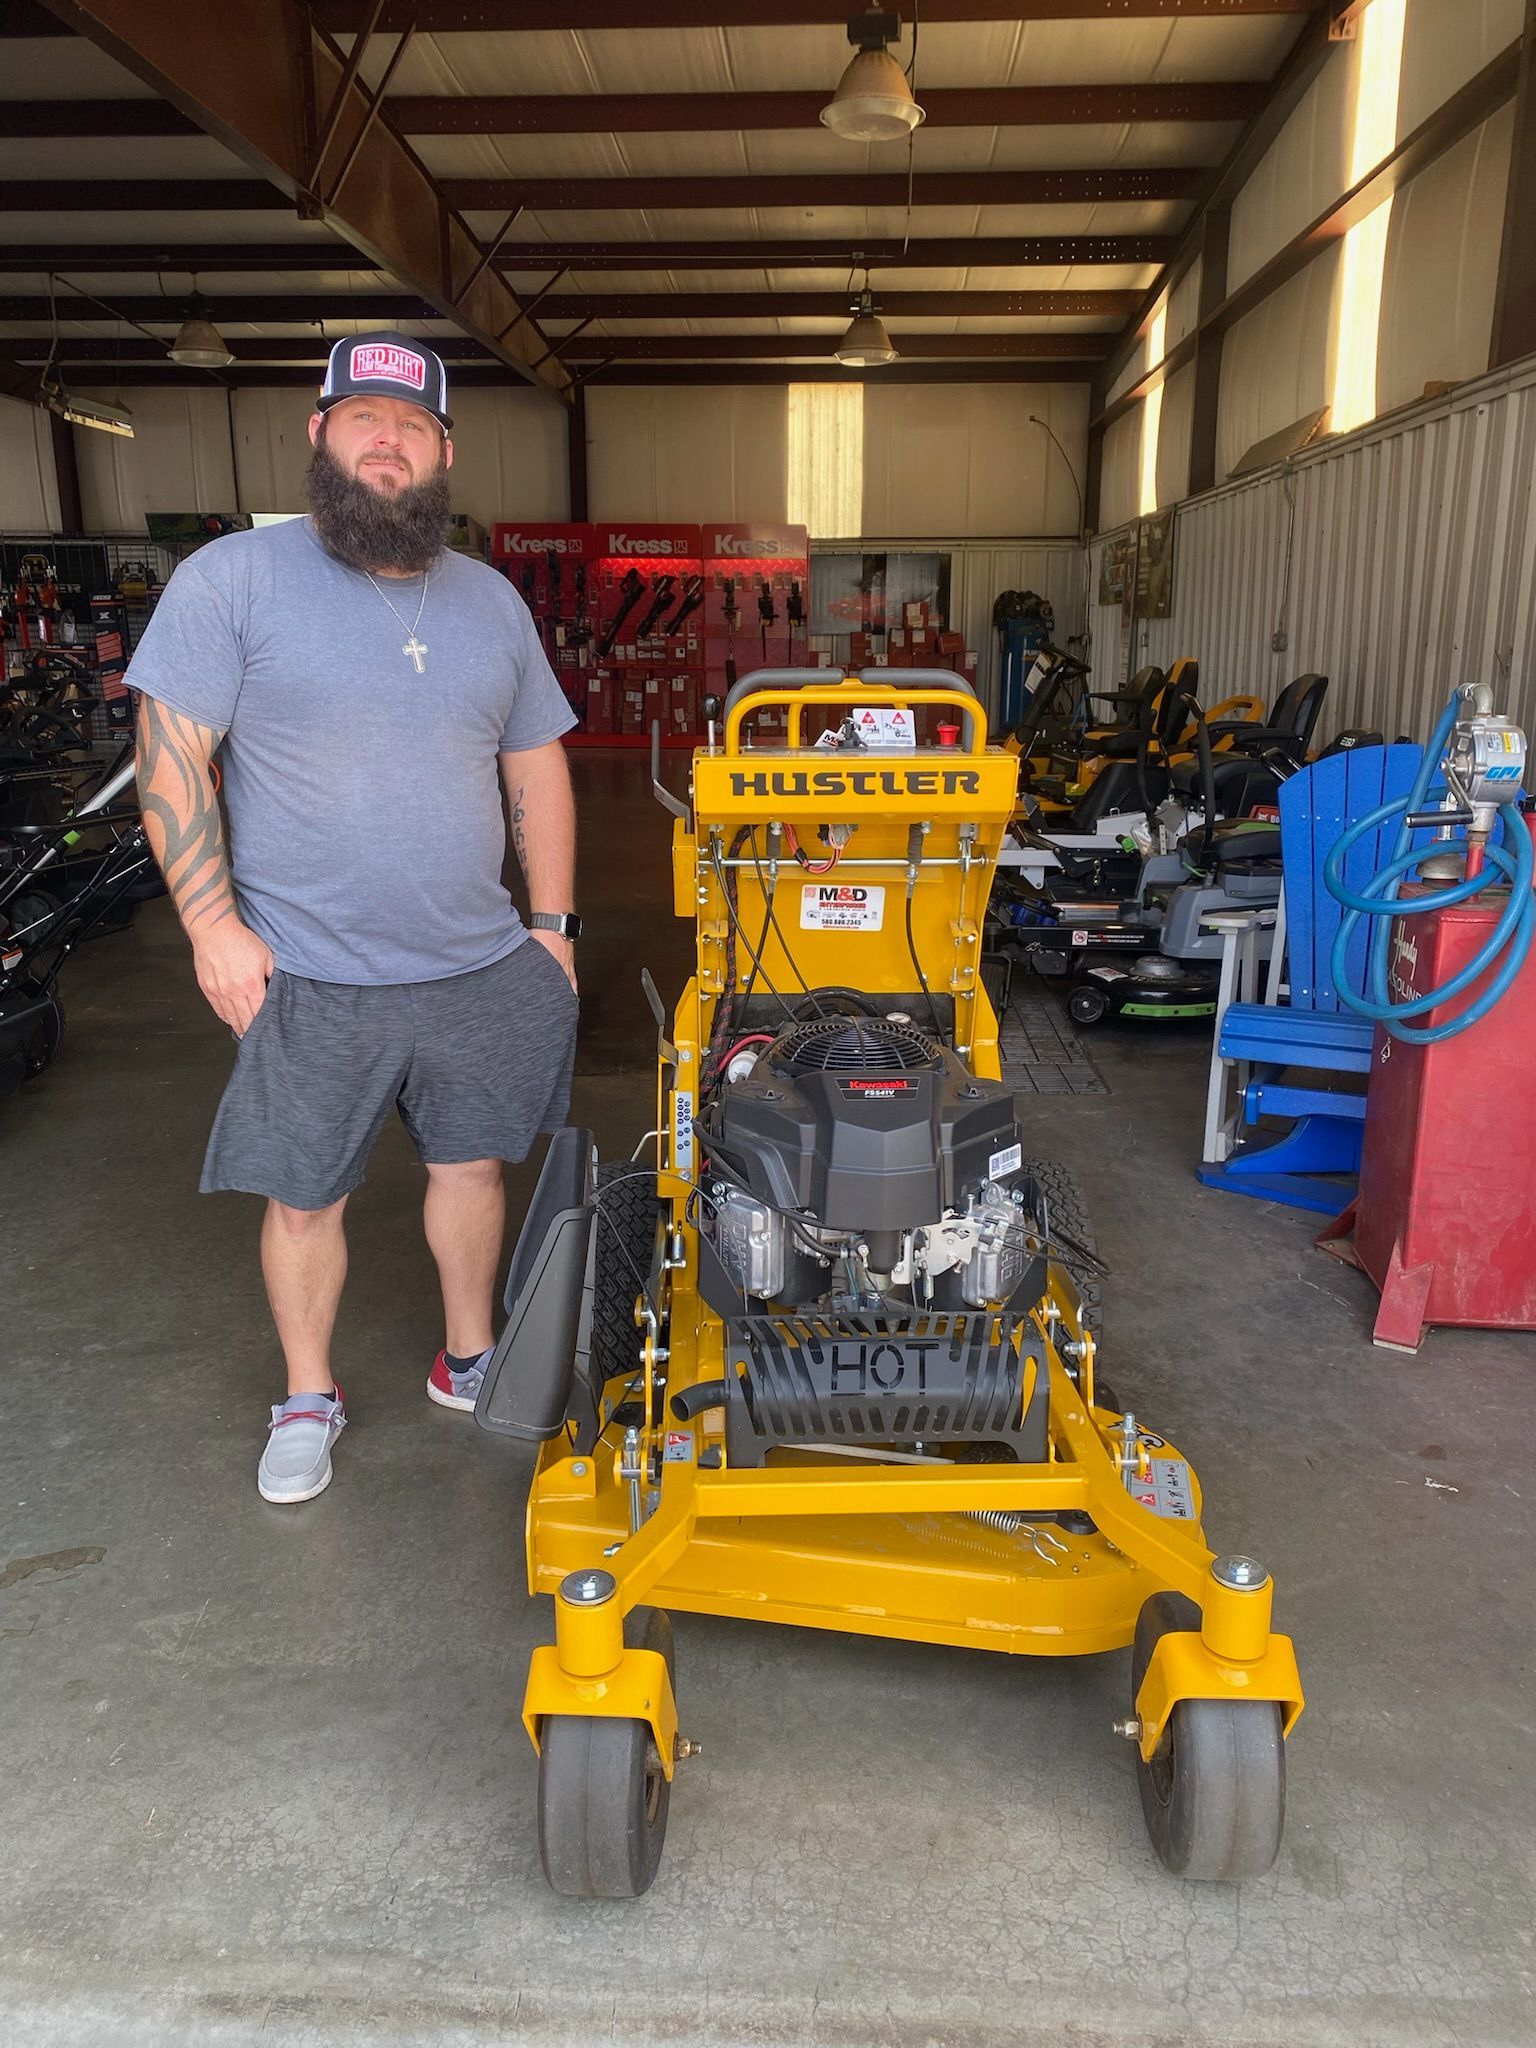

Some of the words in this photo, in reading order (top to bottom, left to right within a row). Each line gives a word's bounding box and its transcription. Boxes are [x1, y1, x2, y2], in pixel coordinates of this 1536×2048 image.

[355, 348, 386, 373] RED
[387, 349, 422, 382] DIRT
[503, 533, 567, 553] Kress
[609, 534, 673, 554] Kress
[714, 534, 780, 555] Kress
[1485, 766, 1522, 779] GPI
[729, 771, 980, 796] HUSTLER
[819, 887, 867, 902] M&D
[1393, 919, 1418, 981] Handy
[849, 1080, 908, 1089] Kawasaki
[864, 1089, 896, 1097] FS541V
[831, 1344, 940, 1391] HOT
